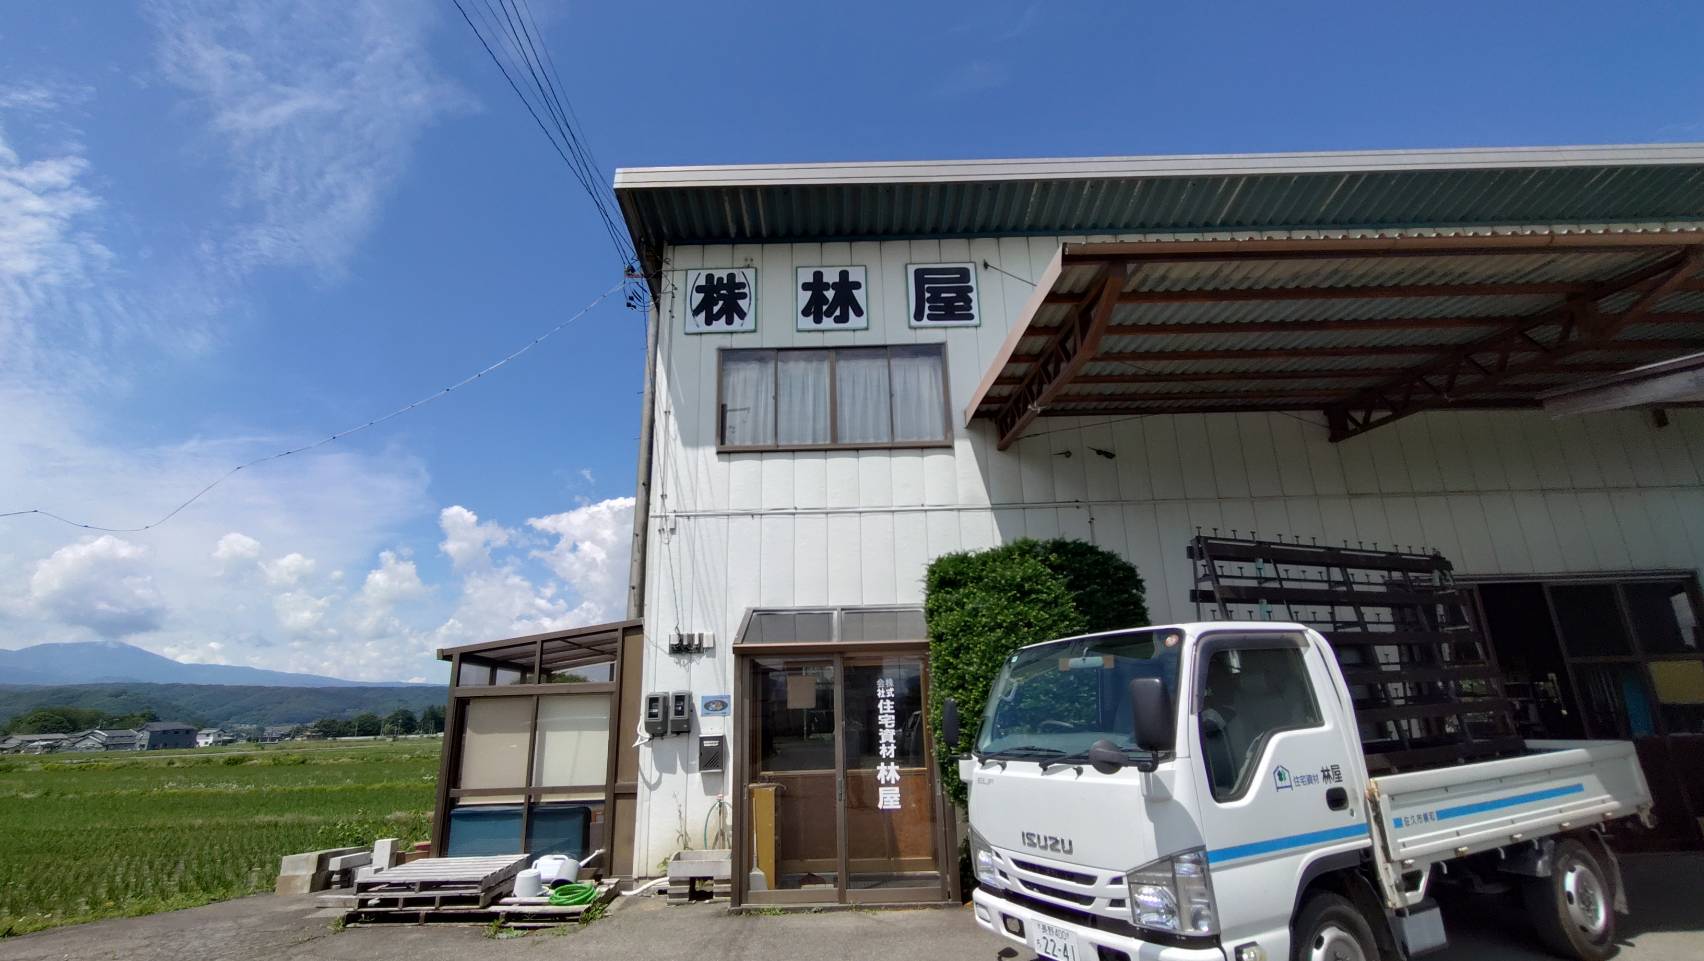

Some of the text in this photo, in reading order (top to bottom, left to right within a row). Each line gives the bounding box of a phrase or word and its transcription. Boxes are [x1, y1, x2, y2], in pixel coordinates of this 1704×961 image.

[878, 699, 897, 758] 住宅資材
[877, 761, 902, 809] 林屋
[1320, 764, 1343, 784] 林屋
[1021, 831, 1074, 856] ISUZU
